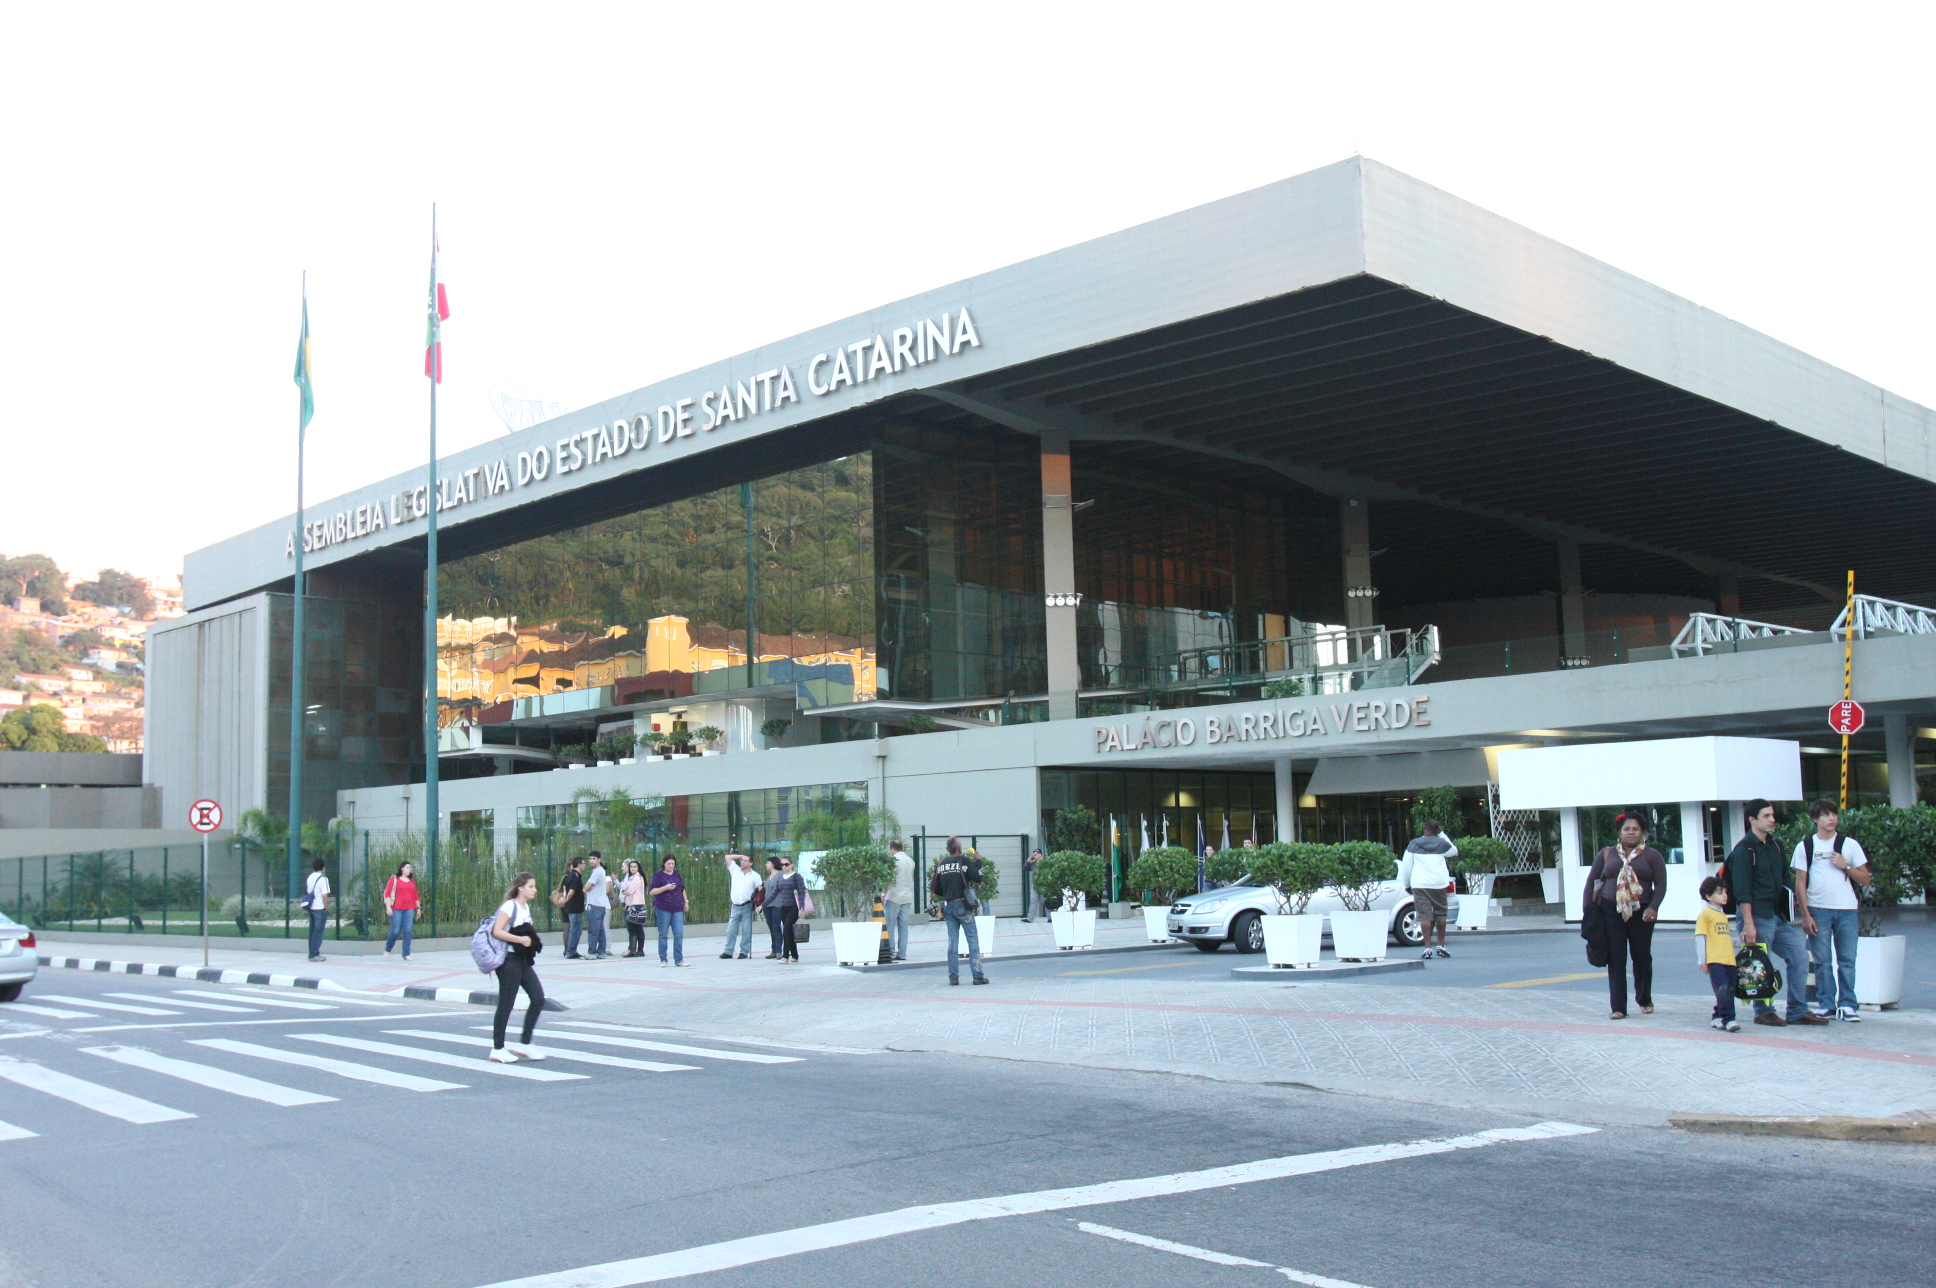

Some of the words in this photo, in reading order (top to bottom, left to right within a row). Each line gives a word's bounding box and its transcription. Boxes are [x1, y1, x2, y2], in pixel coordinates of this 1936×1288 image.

[285, 500, 388, 558] ASEMBLEIA
[517, 445, 550, 486] DO
[556, 411, 651, 474] ESTADO
[657, 397, 695, 443] DE
[701, 365, 800, 432] SANTA
[807, 306, 981, 396] CATARINA
[1095, 715, 1195, 752] PALÁCIO
[1205, 705, 1327, 744] BARRIGA
[1330, 695, 1431, 733] VERDE
[1841, 702, 1852, 732] PARE
